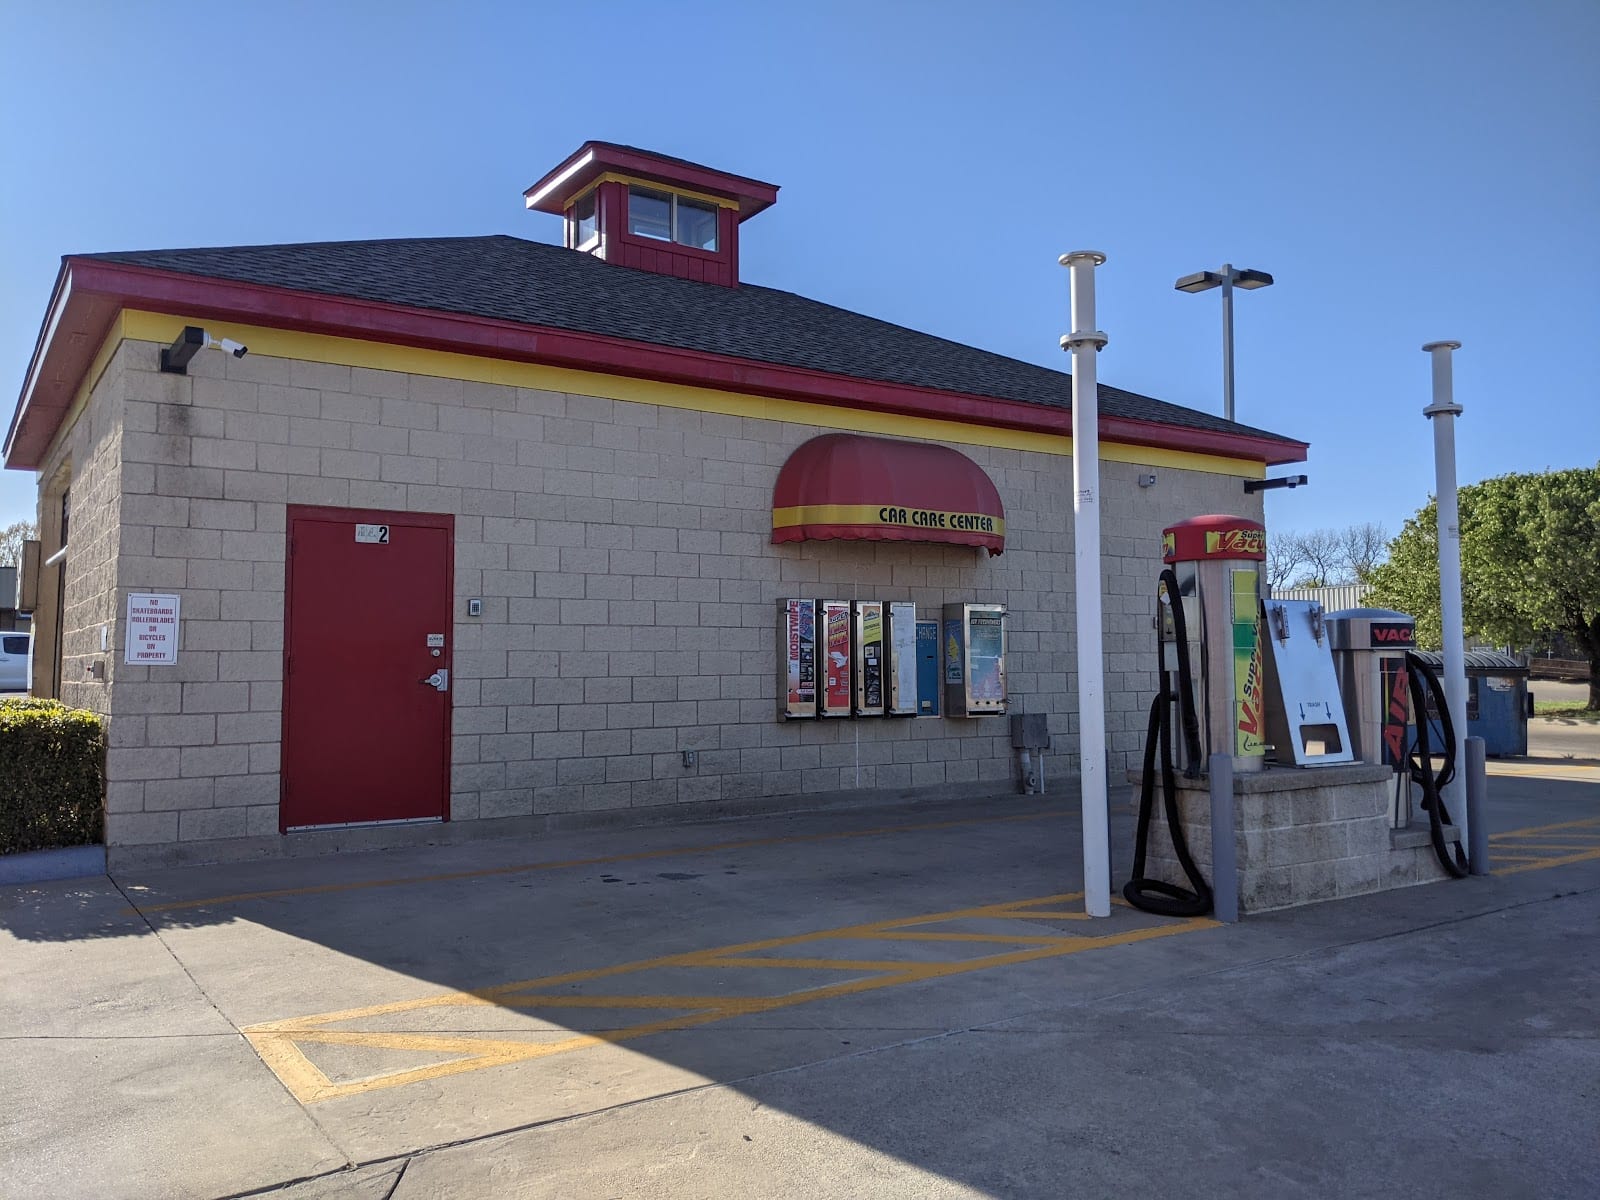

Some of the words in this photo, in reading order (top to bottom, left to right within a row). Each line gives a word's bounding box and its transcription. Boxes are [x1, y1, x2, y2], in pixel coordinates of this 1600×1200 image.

[880, 507, 907, 524] CAR
[912, 510, 945, 528] CARE
[949, 514, 993, 532] CENTER
[378, 526, 388, 543] 2
[1384, 665, 1409, 763] AIR
